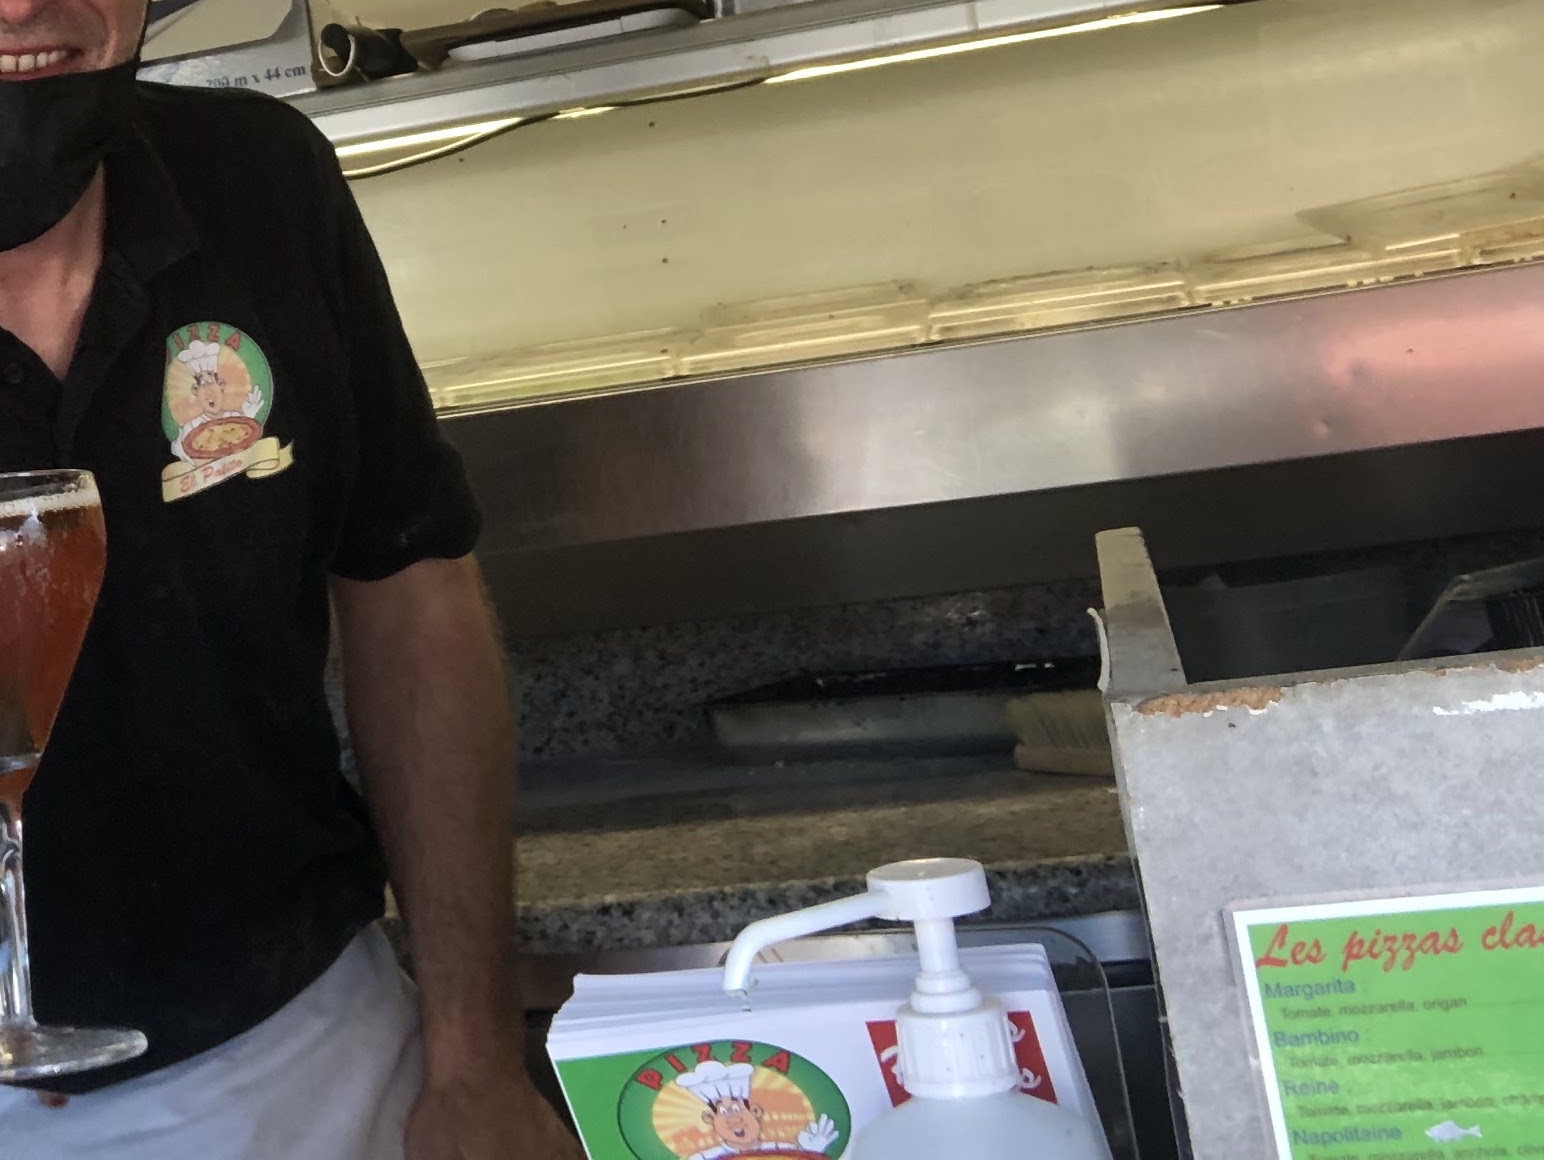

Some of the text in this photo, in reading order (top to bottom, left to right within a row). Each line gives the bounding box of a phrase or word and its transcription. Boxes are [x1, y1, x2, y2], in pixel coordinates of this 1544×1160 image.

[264, 67, 281, 80] 44
[284, 65, 306, 78] cm
[1255, 923, 1327, 968] Les
[1341, 928, 1463, 972] pizzas
[1264, 978, 1356, 1001] Margarita
[1273, 1030, 1361, 1048] Bambino
[635, 1040, 791, 1091] PIZZA
